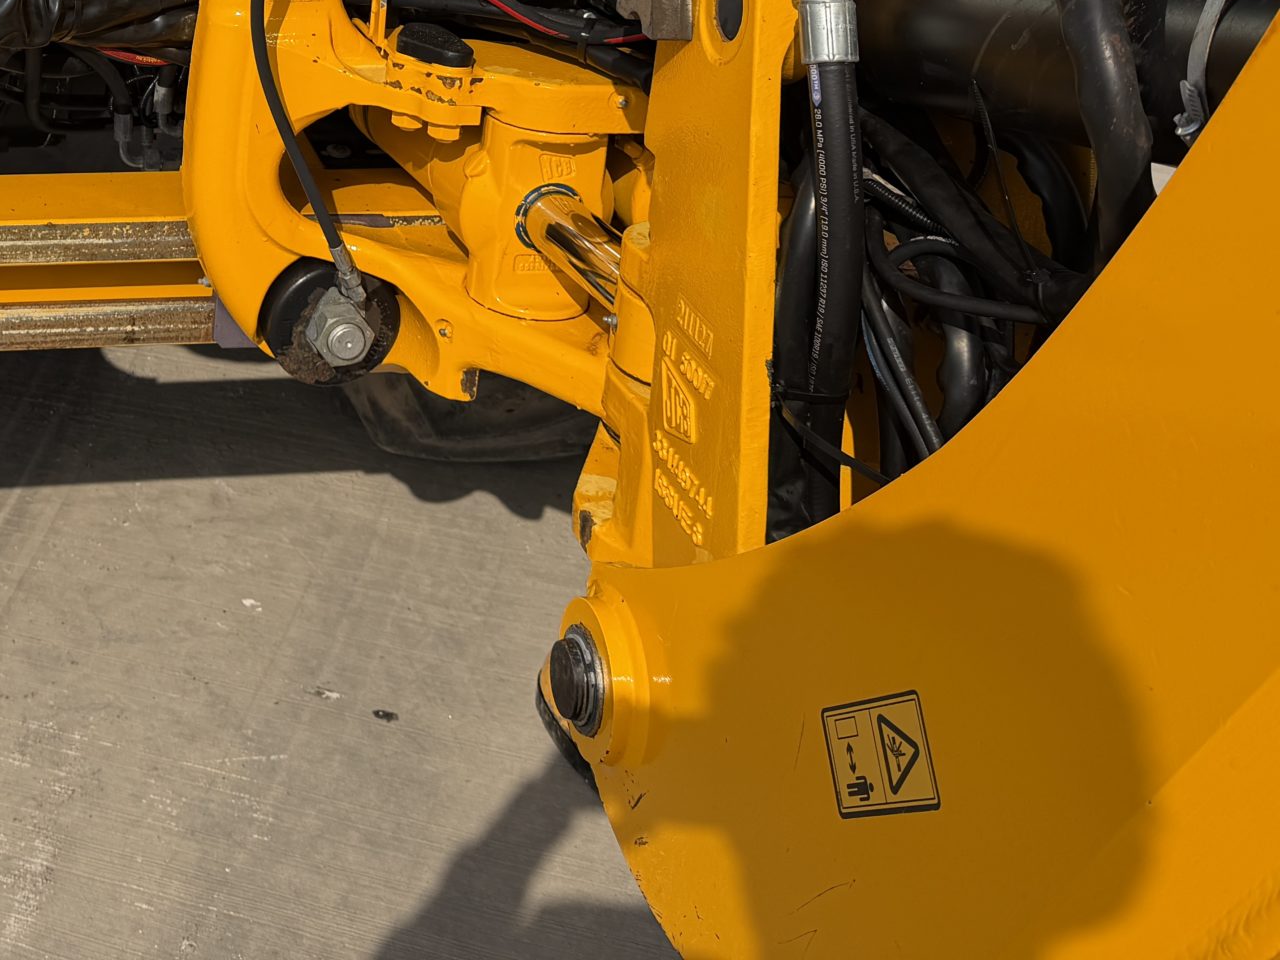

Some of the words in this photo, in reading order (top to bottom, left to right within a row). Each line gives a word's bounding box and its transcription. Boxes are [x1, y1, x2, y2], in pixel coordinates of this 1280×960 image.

[814, 108, 822, 128] 28.0
[816, 129, 824, 148] MPa
[817, 150, 826, 176] (4000
[819, 177, 827, 195] PSI)
[821, 238, 829, 258] mm)
[666, 368, 691, 438] JCB
